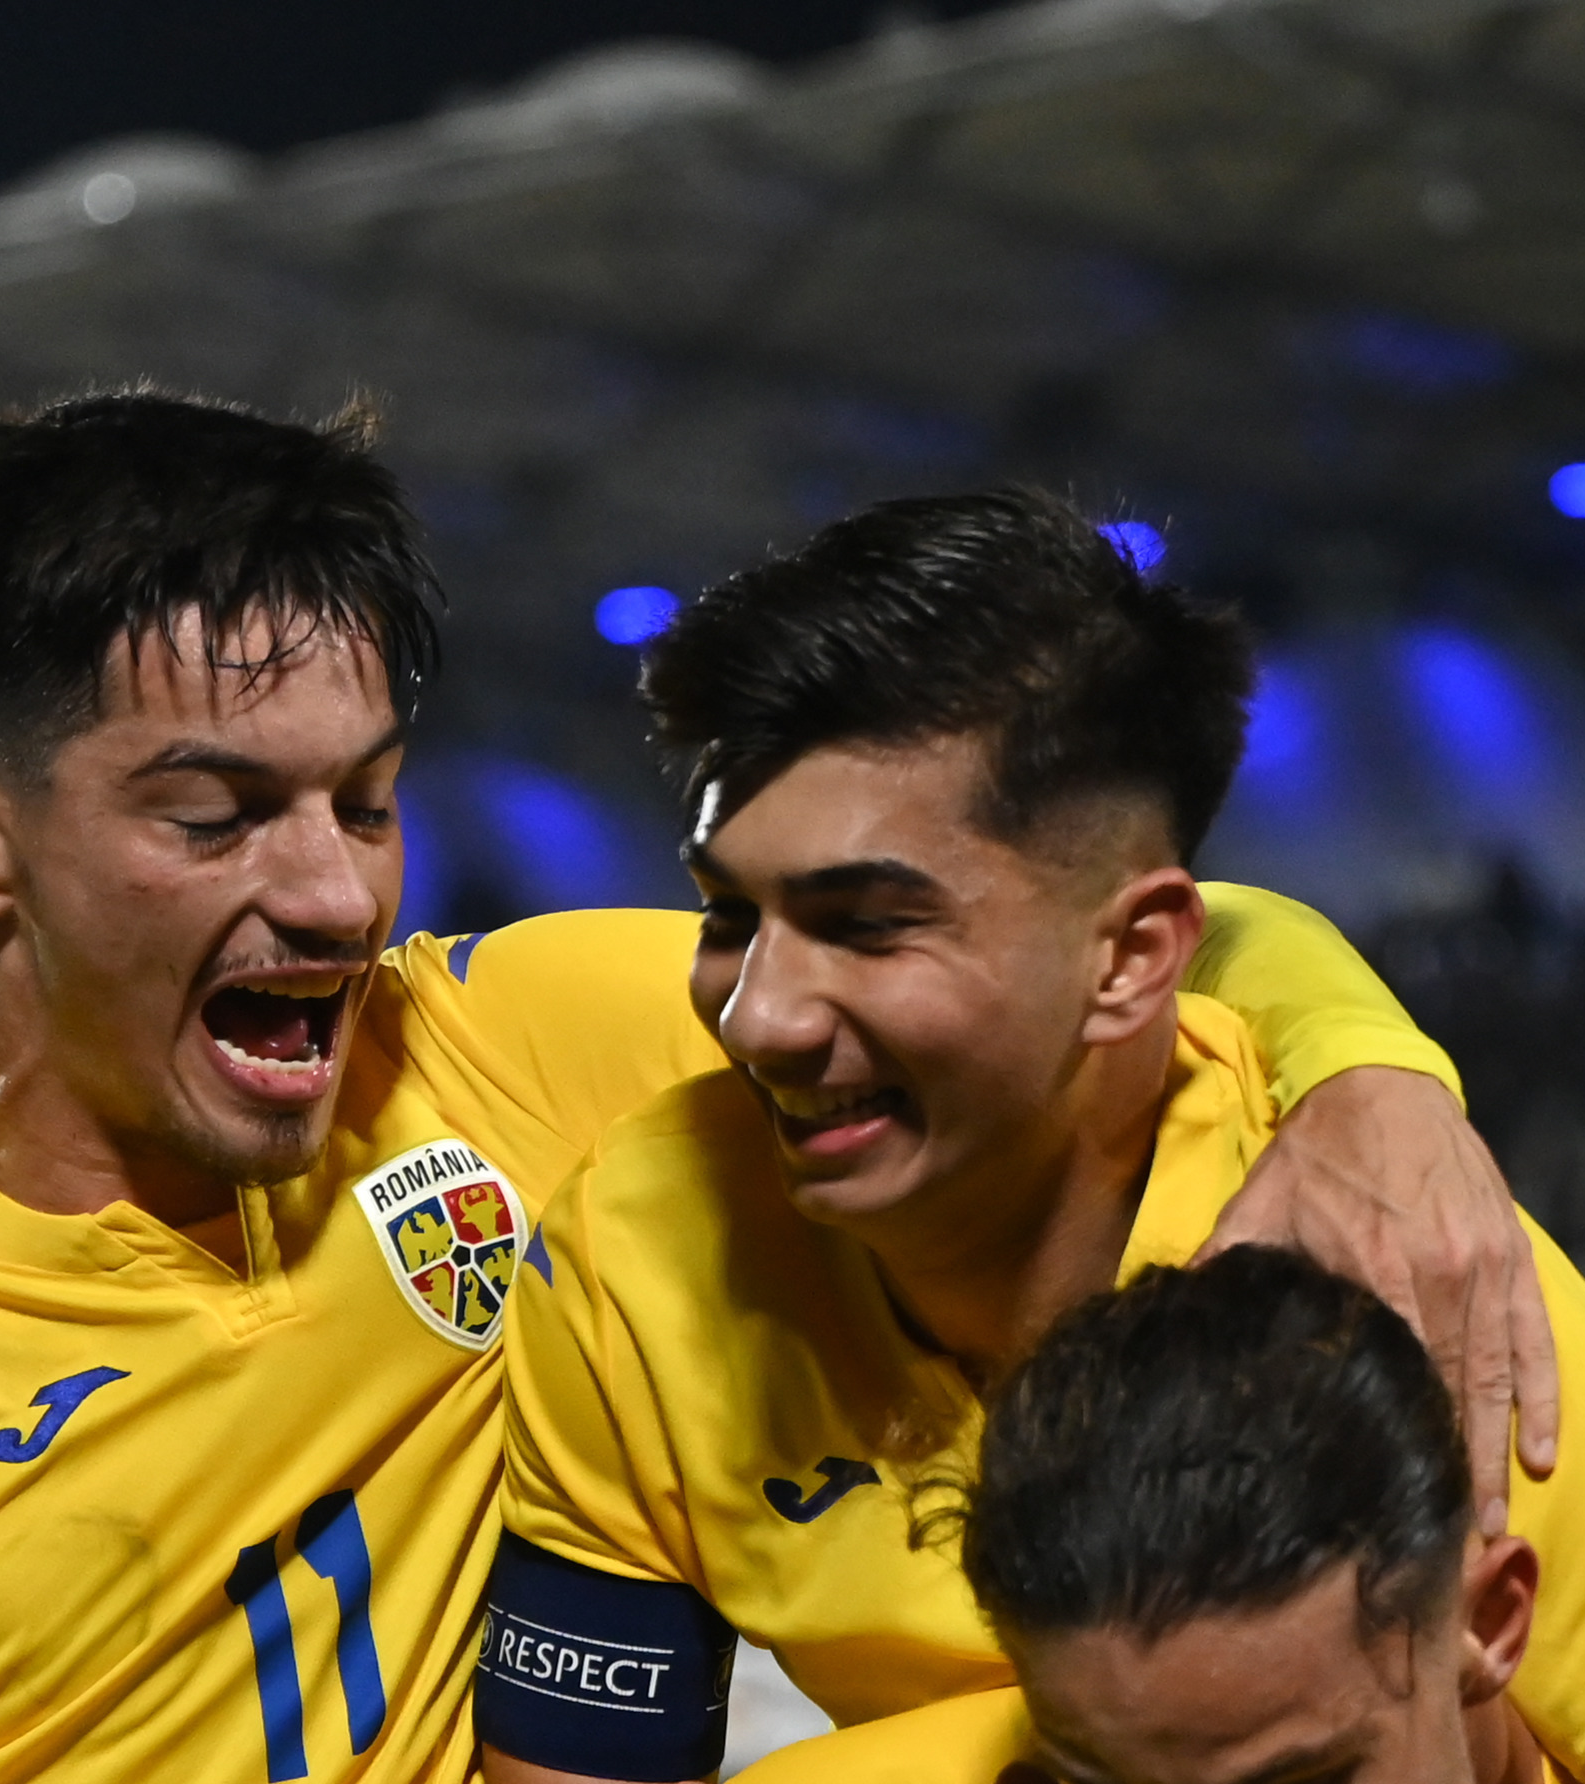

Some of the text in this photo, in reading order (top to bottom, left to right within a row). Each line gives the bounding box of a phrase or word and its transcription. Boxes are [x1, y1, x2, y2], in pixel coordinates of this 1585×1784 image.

[370, 1148, 489, 1213] ROMÂNIA
[223, 1488, 387, 1784] 11
[498, 1628, 671, 1699] RESPECT
